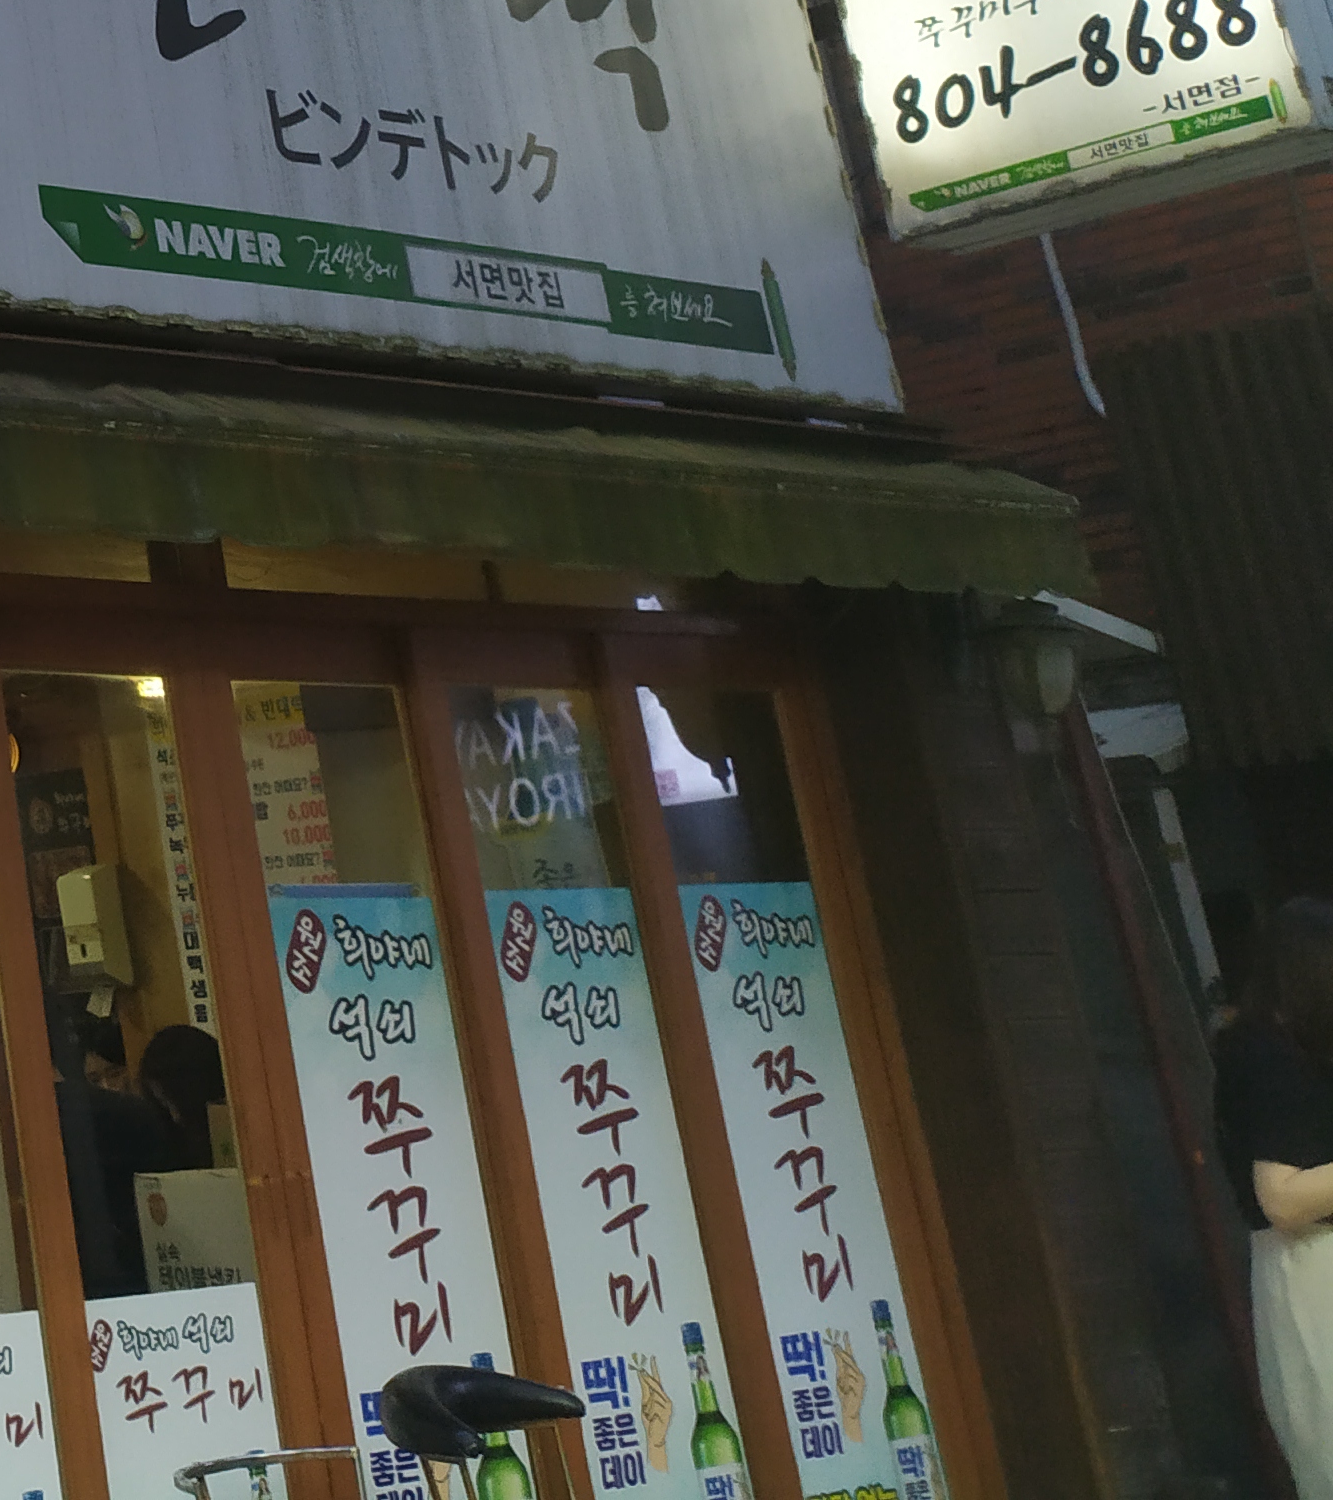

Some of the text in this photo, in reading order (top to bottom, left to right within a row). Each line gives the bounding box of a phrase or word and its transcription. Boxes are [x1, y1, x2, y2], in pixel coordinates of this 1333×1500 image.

[265, 87, 560, 206] ビンデトック
[953, 172, 1012, 199] NAVER
[1088, 132, 1150, 162] 서면맛집
[153, 217, 286, 269] NAVER
[449, 255, 565, 311] 서면맛집
[333, 913, 433, 982] 희야네
[541, 904, 634, 970] 희야네
[730, 898, 816, 959] 희야네
[329, 993, 416, 1062] 석쇠
[541, 981, 621, 1046] 석쇠
[733, 970, 805, 1032] 석쇠
[560, 1058, 665, 1327] 쭈꾸미
[751, 1044, 855, 1303] 쭈꾸미
[348, 1075, 453, 1356] 쭈꾸미
[116, 1312, 234, 1360] 희야네 석쇠
[115, 1365, 264, 1433] 쭈꾸미
[598, 1451, 648, 1490] 데이
[798, 1421, 844, 1460] 데이
